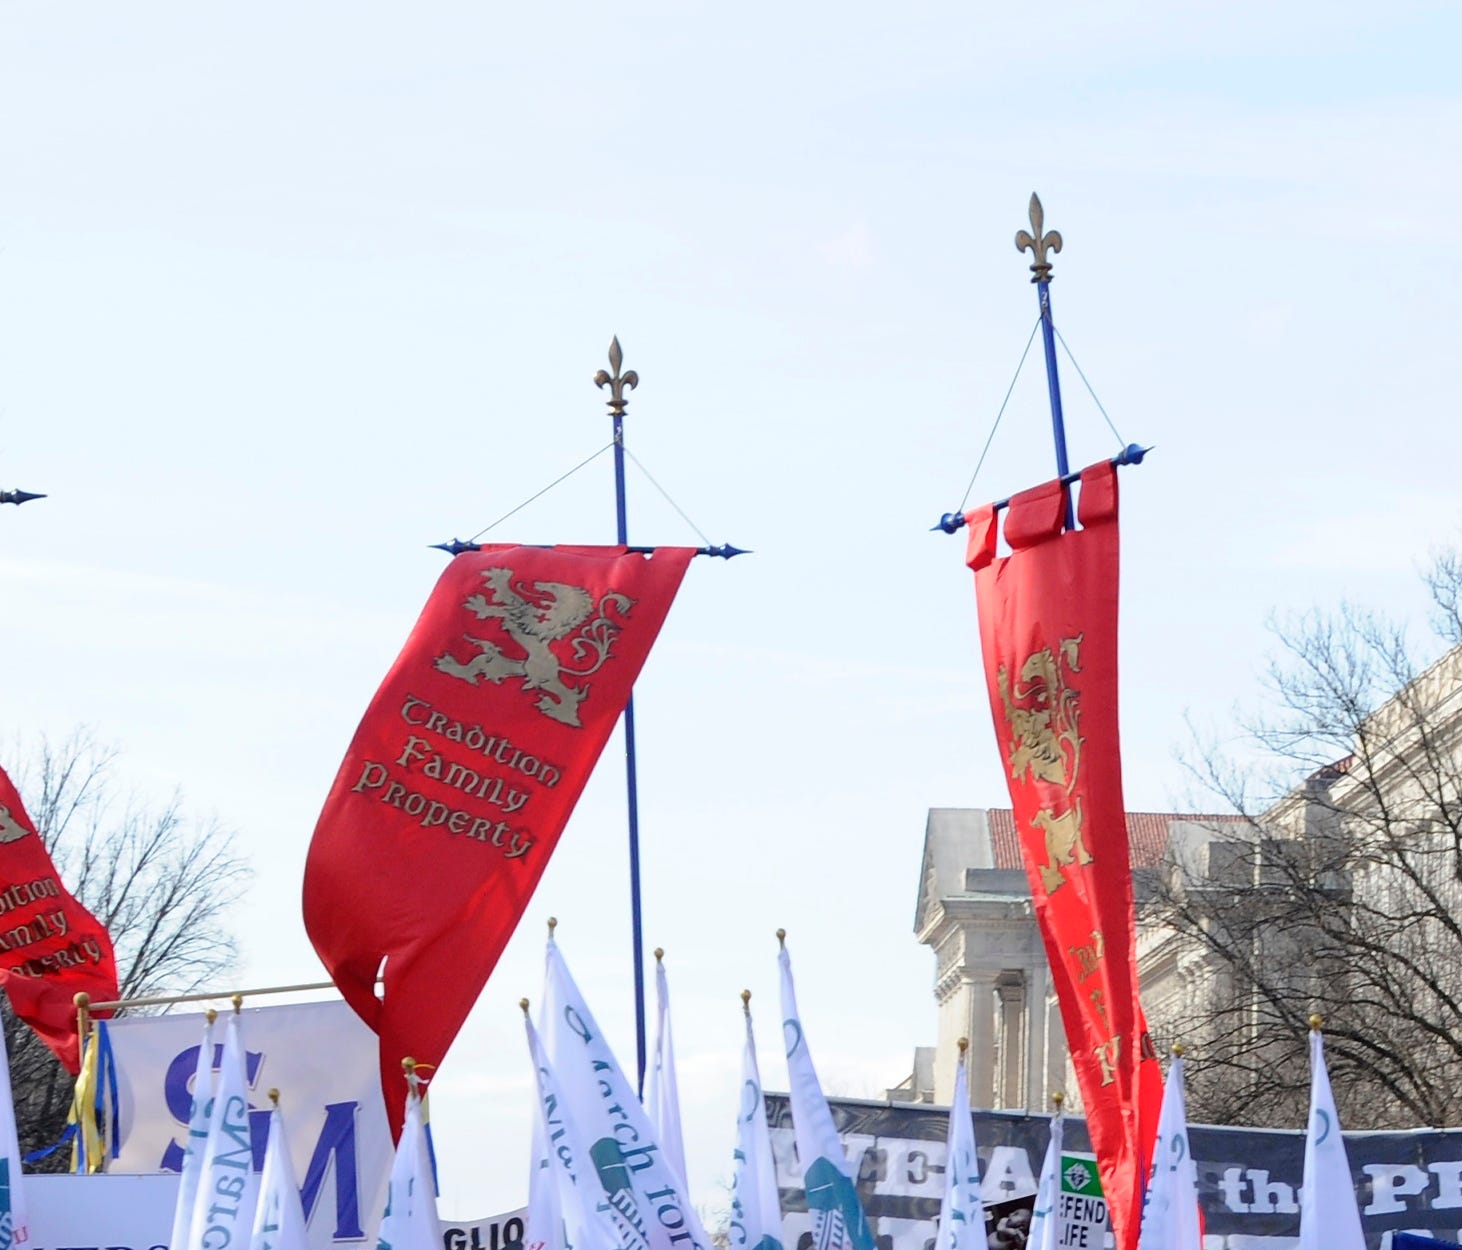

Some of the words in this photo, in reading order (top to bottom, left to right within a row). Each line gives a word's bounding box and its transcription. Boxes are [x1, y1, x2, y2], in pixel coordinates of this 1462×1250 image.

[396, 735, 529, 813] Family
[401, 694, 560, 788] Tradition
[352, 761, 534, 858] Property
[1218, 1168, 1303, 1214] th
